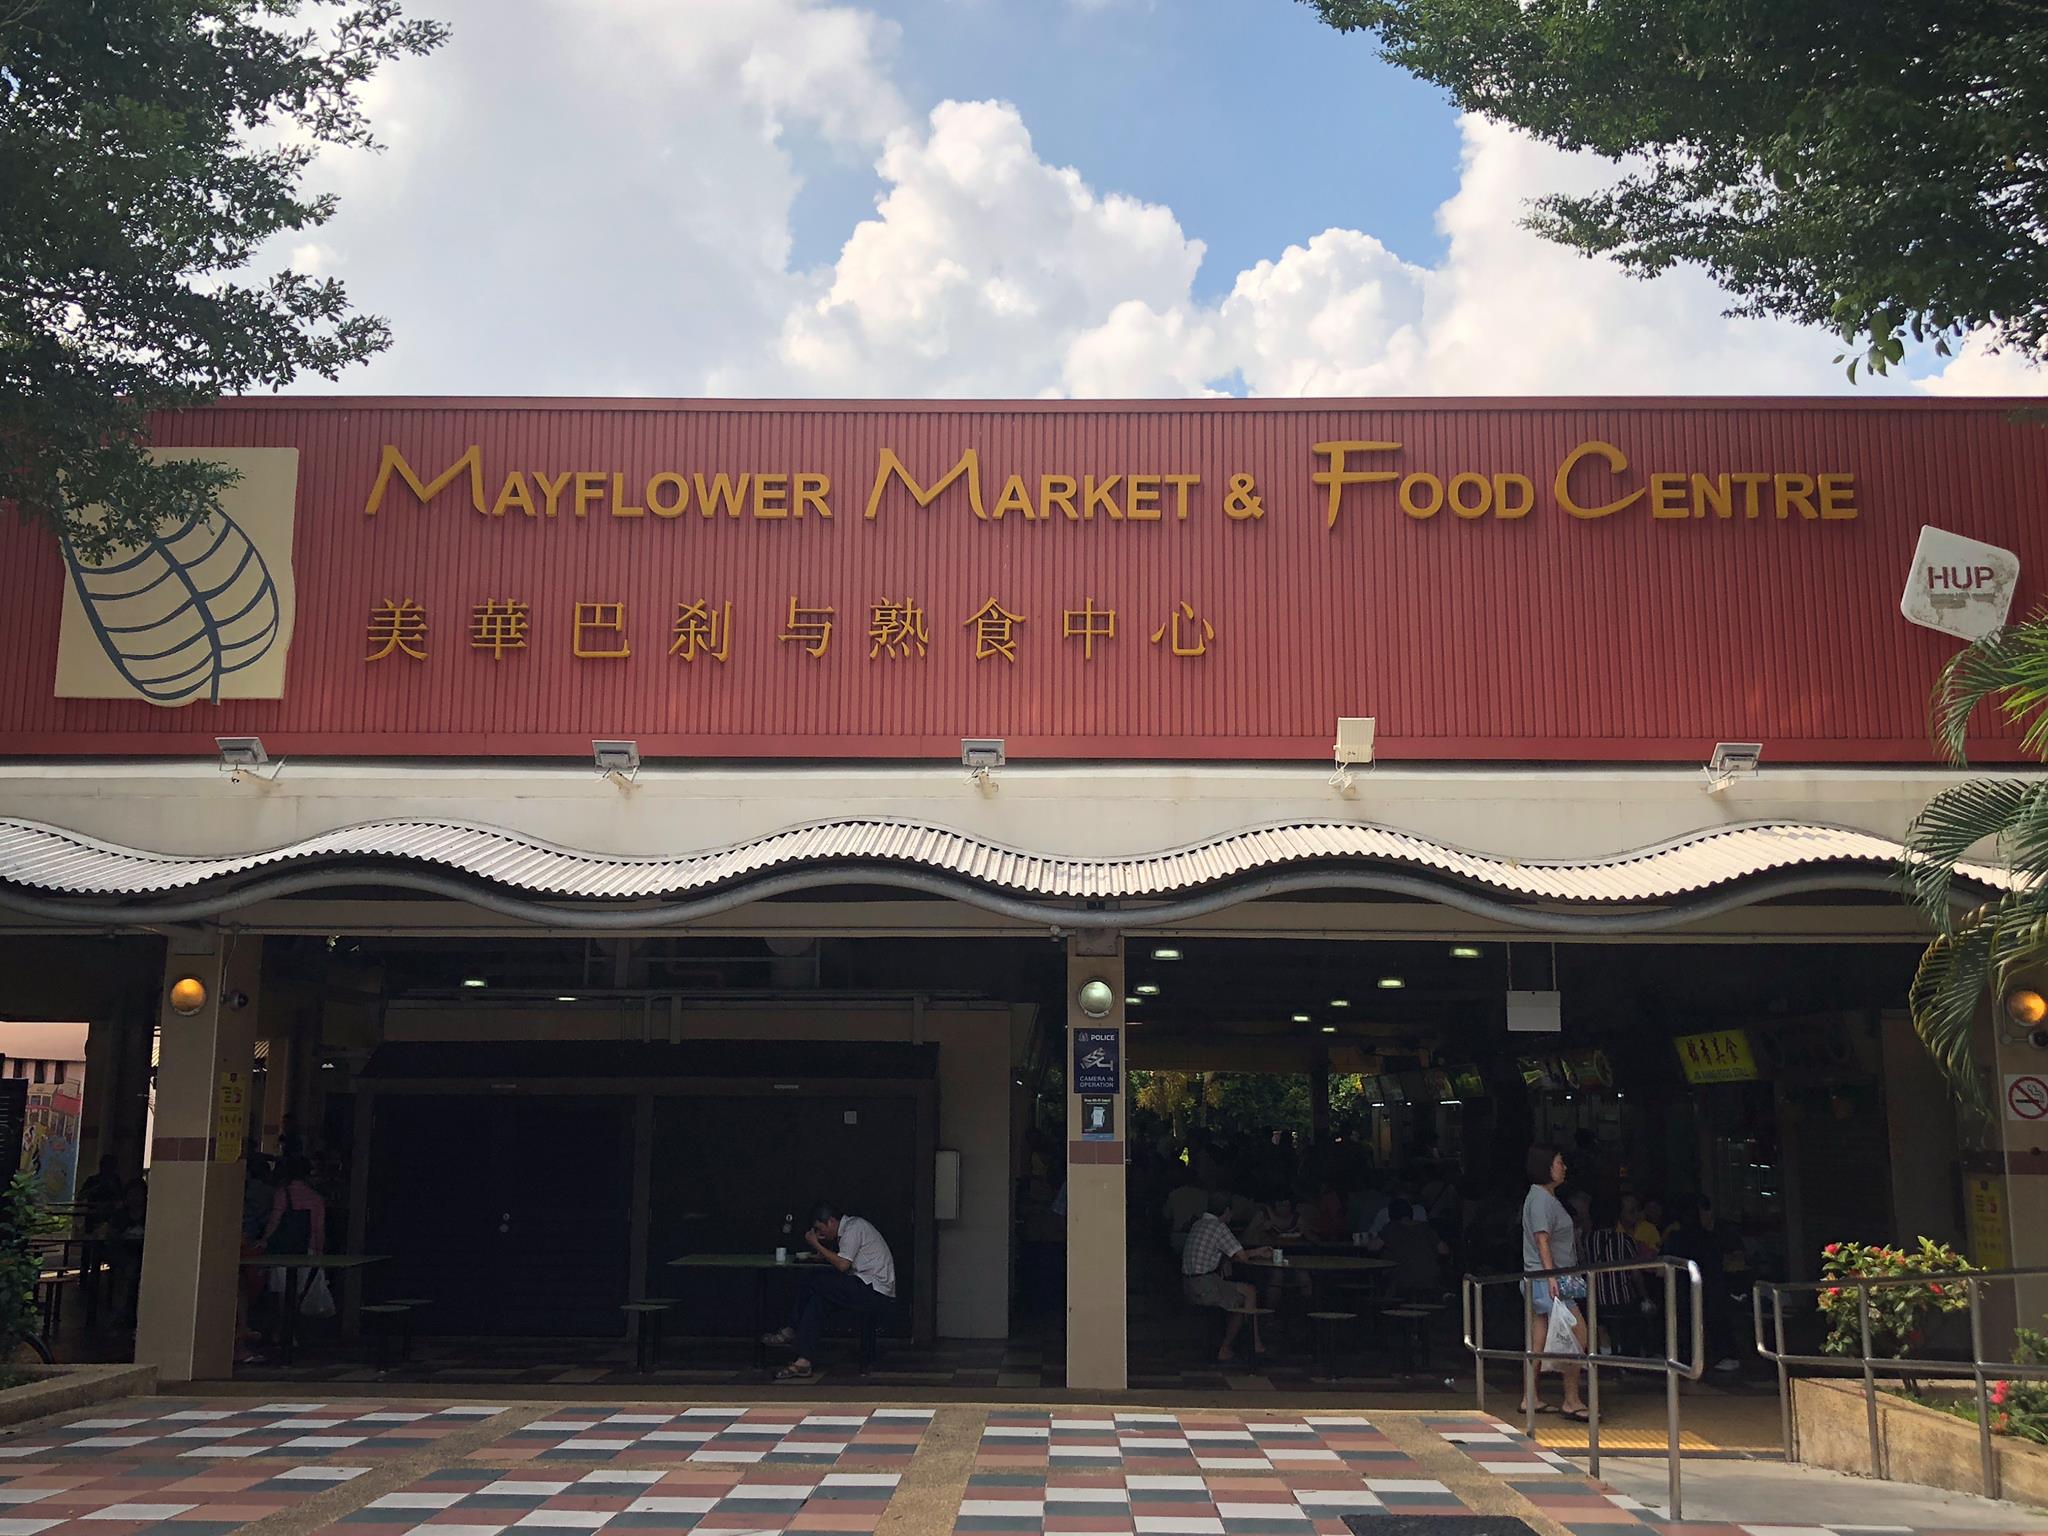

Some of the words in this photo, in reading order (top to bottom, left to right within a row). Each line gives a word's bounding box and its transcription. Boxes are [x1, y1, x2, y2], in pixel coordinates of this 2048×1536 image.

[365, 444, 832, 518] MAYFLOWER
[867, 446, 1200, 521] MARKET
[1222, 473, 1266, 518] &
[1311, 440, 1535, 530] FOOD
[1553, 440, 1859, 521] CENTRE
[1927, 566, 1995, 589] HUP
